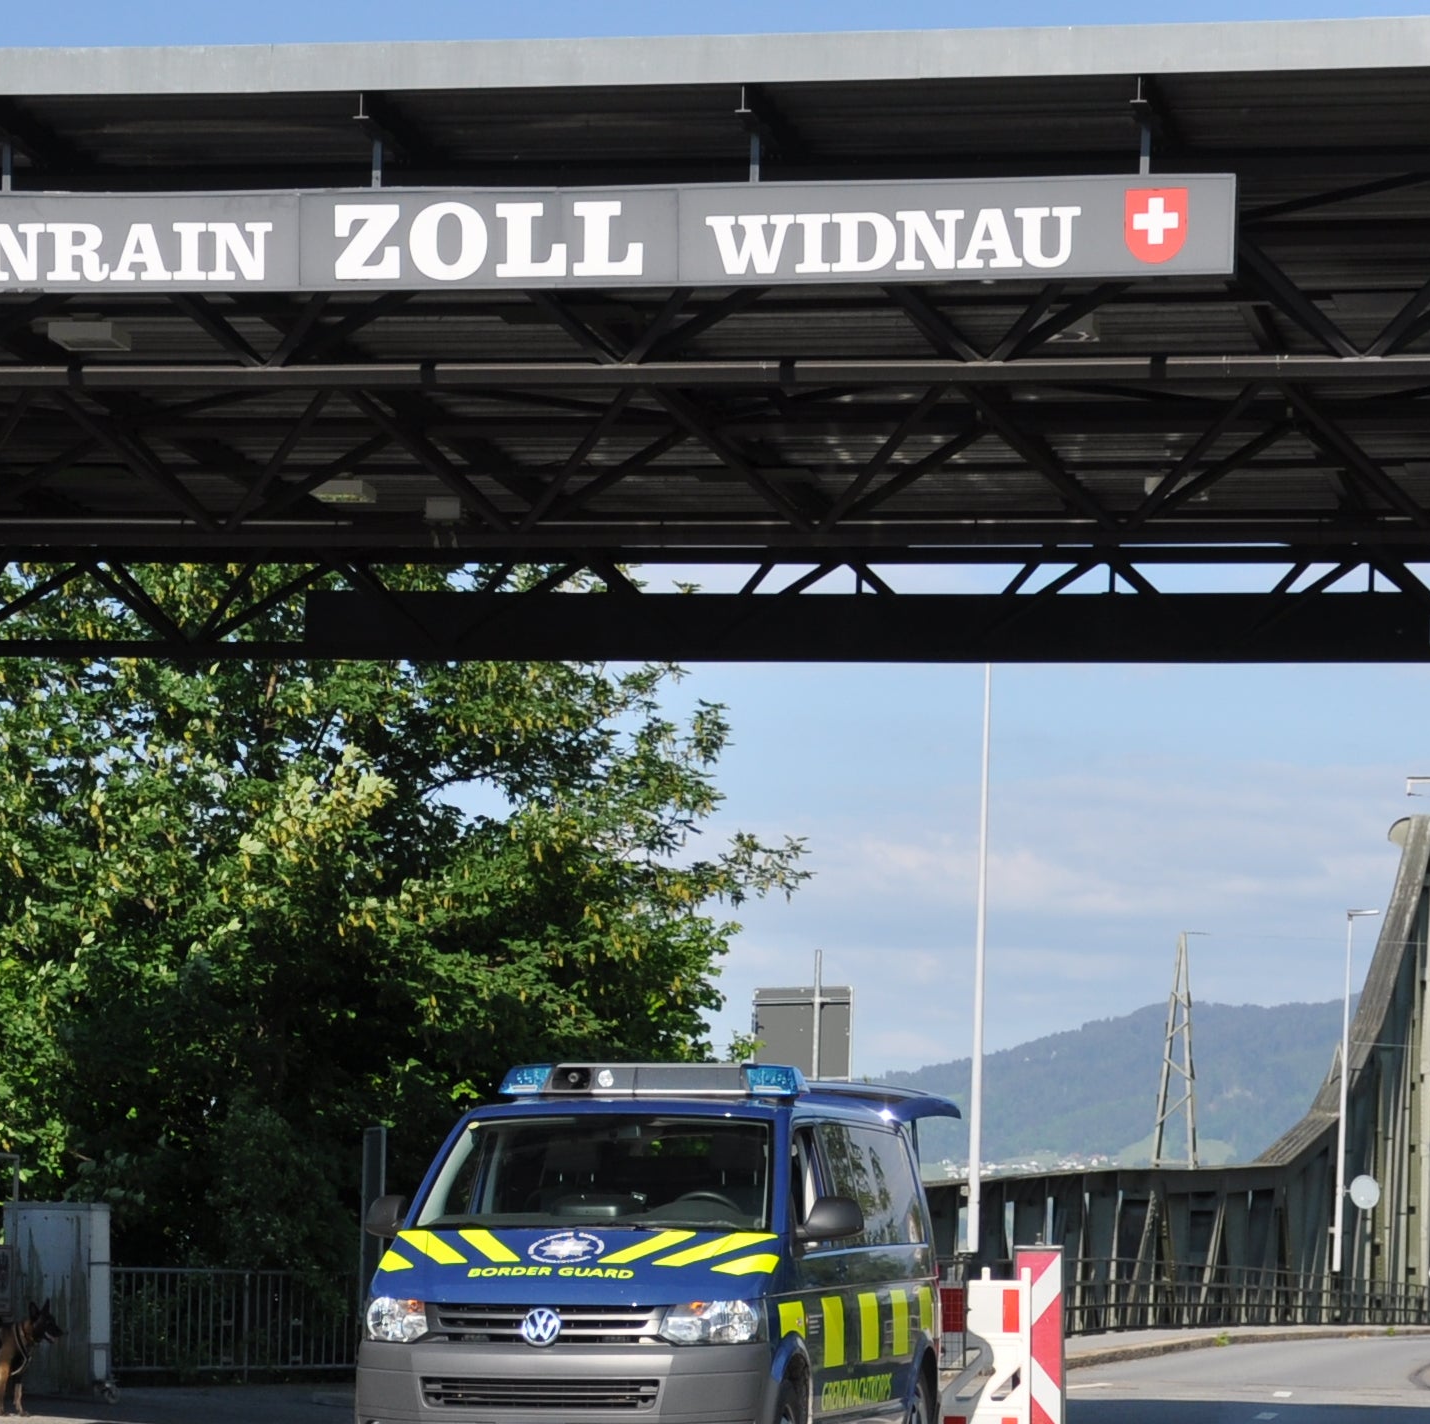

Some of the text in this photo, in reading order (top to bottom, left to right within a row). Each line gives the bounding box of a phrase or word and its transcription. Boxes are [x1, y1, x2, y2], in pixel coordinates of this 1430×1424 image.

[333, 200, 644, 280] ZOLL
[705, 205, 1082, 275] WIDNAU
[467, 1265, 635, 1279] BORDER GUARD
